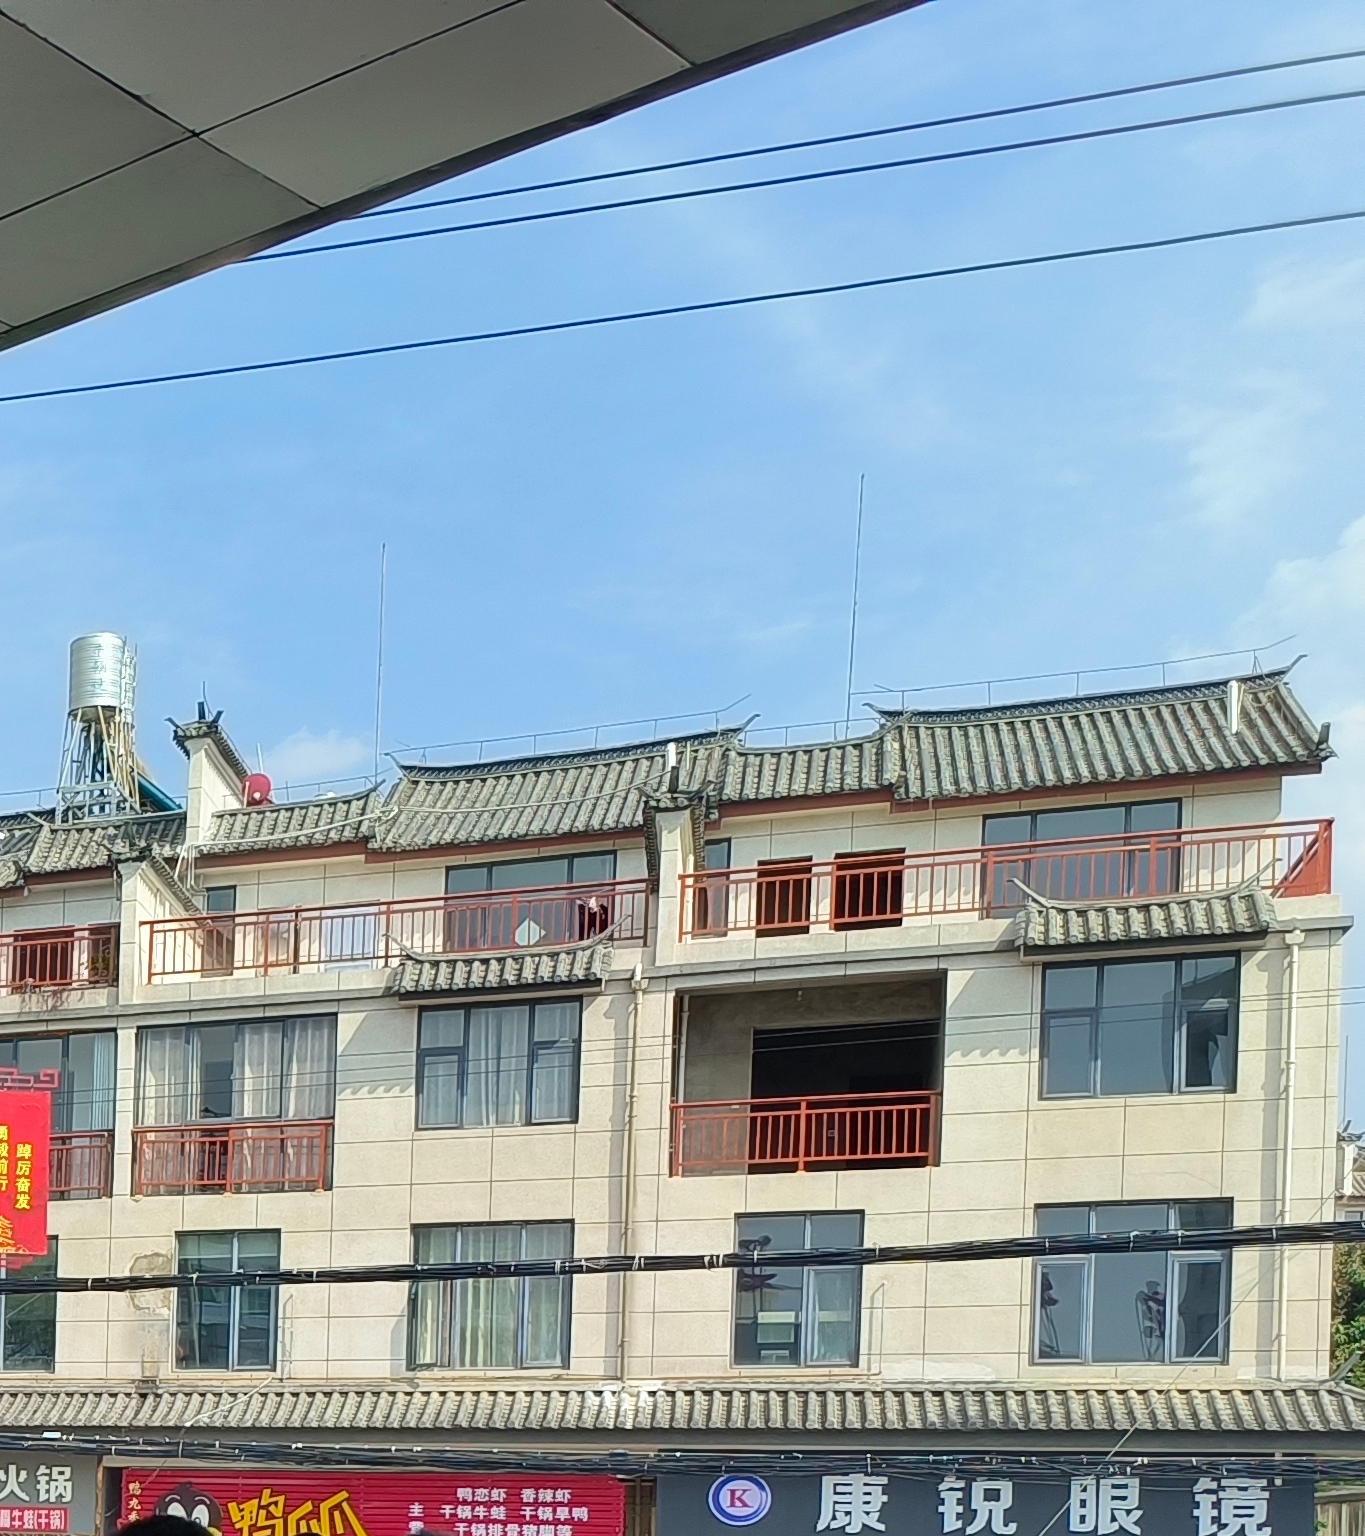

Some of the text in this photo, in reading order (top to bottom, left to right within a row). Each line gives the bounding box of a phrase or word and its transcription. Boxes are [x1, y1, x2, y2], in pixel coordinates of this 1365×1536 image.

[15, 1143, 32, 1210] 踔厉奋发
[520, 1488, 572, 1503] 香辣虾
[726, 1486, 751, 1509] K
[439, 1504, 508, 1520] 干锅牛蛙
